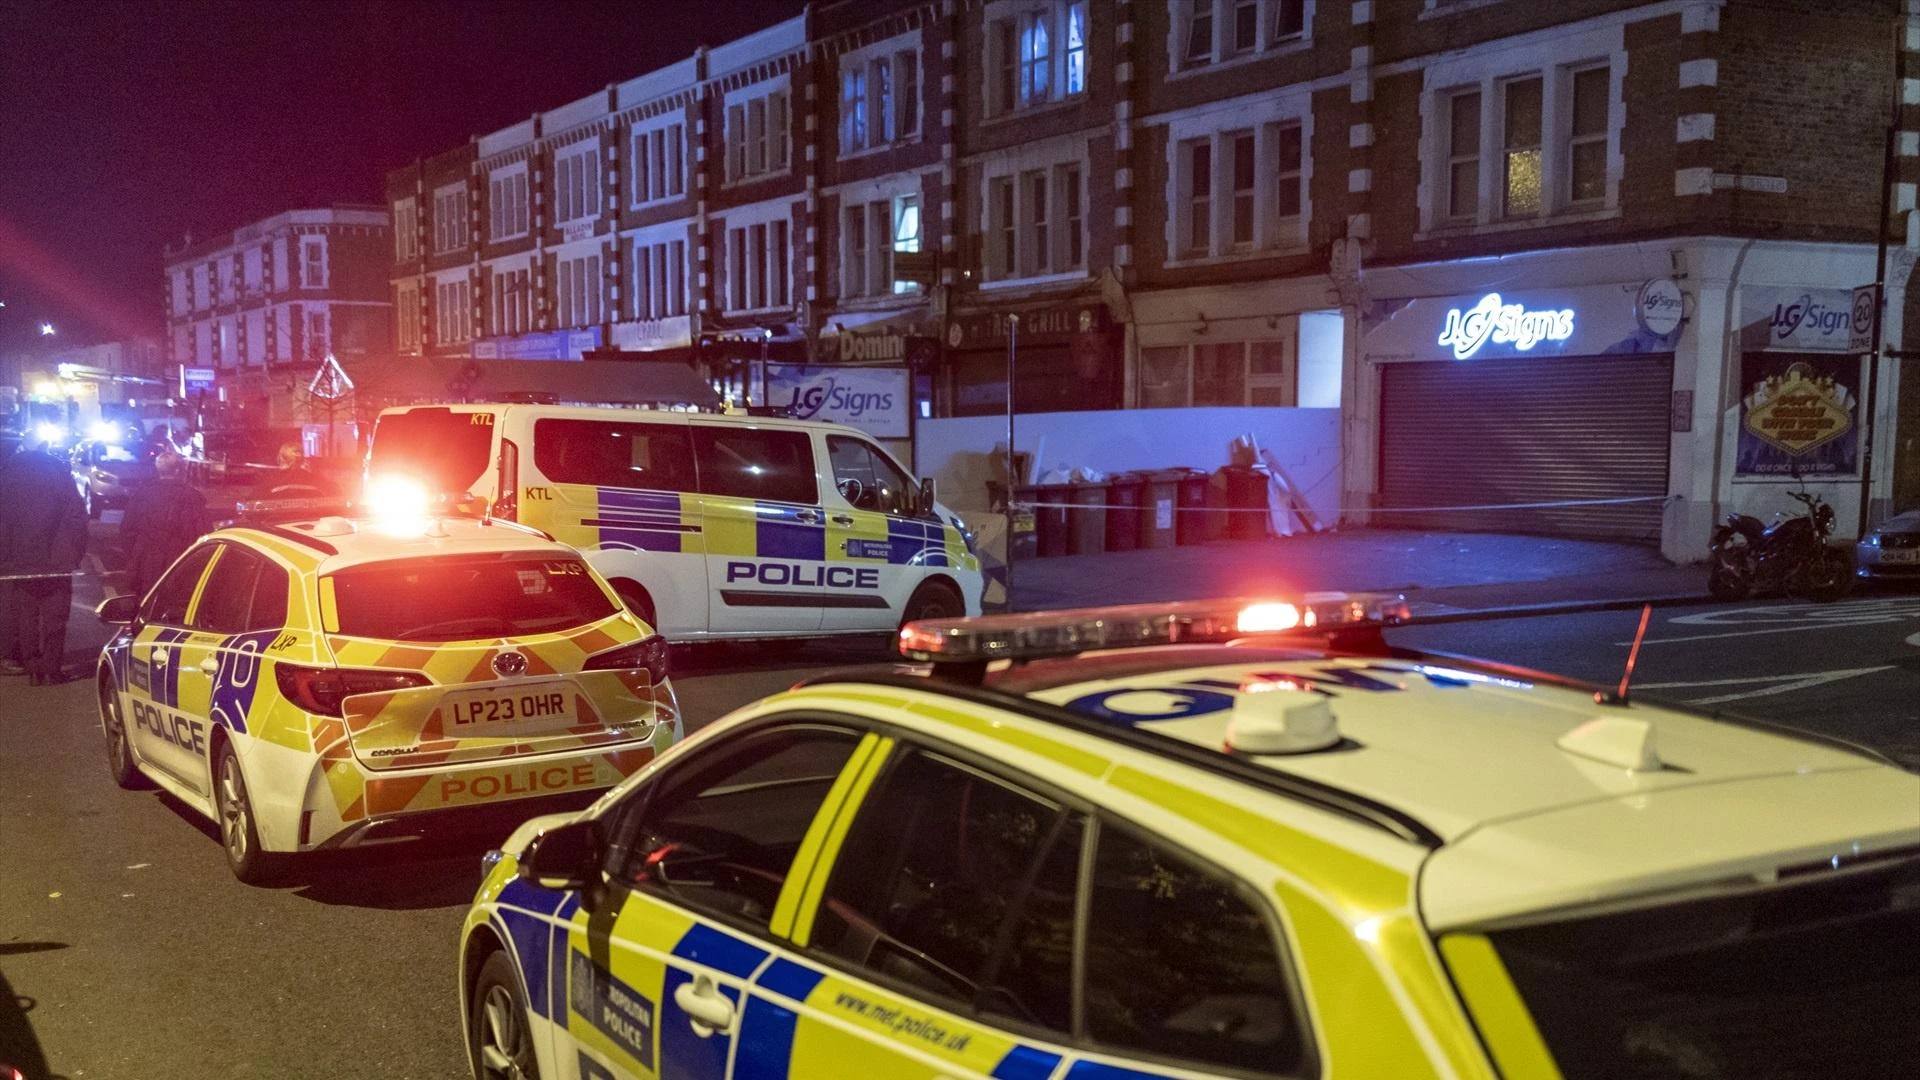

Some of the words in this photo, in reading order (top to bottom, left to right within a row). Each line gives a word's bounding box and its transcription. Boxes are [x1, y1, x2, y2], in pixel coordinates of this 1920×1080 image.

[1493, 305, 1575, 350] Signs
[1769, 299, 1804, 333] J.G
[1805, 304, 1850, 336] Sign
[1856, 304, 1871, 323] 20
[786, 382, 825, 415] J.G
[829, 386, 893, 416] Signs
[471, 413, 493, 425] KTL
[526, 487, 552, 500] KTL
[544, 562, 583, 575] LXP
[727, 561, 879, 589] POLICE
[270, 634, 297, 651] LXP
[454, 699, 515, 725] LP23
[521, 693, 565, 718] OHR
[132, 699, 206, 758] POLICE
[440, 764, 596, 801] POLICE
[603, 1005, 642, 1051] POLICE
[834, 992, 971, 1052] www.met.police.uk
